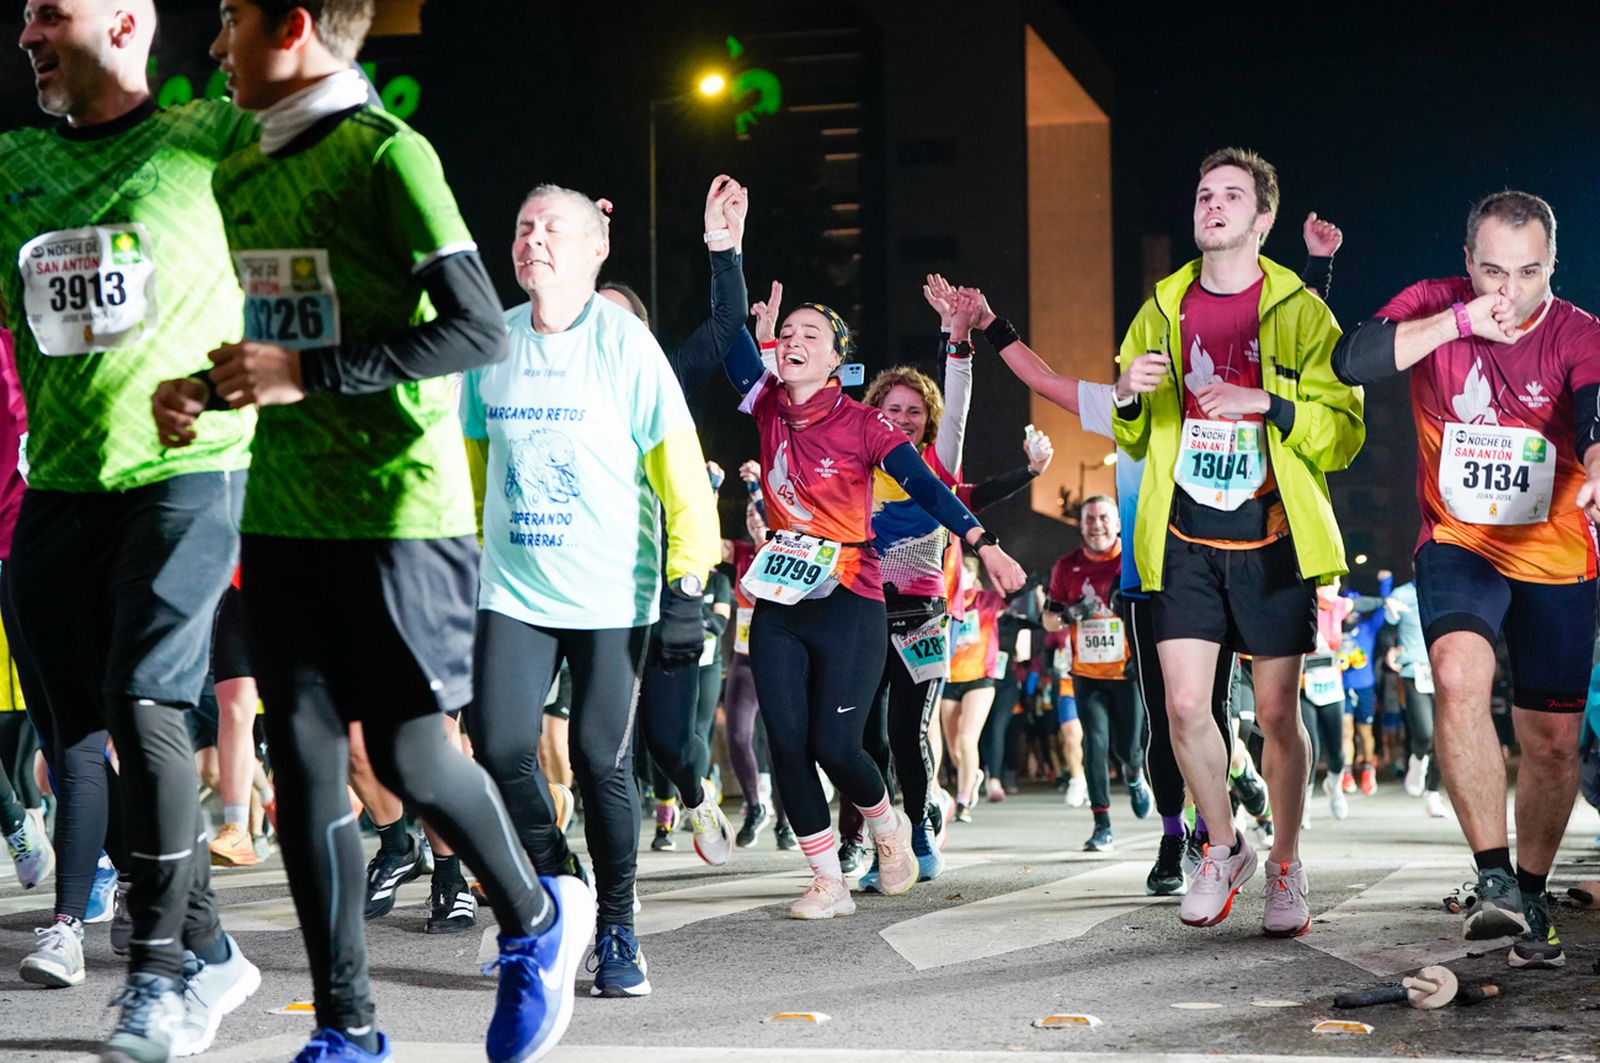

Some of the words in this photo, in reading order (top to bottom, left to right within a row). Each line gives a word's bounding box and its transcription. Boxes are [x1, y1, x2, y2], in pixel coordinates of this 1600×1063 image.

[47, 243, 82, 257] NOCHE
[85, 240, 98, 254] DE
[36, 260, 59, 275] SAN
[49, 271, 127, 312] 3913
[1190, 440, 1207, 450] SAN
[1468, 436, 1498, 447] NOCHE
[1501, 439, 1513, 449] DE
[1454, 446, 1475, 458] SAN
[1463, 460, 1530, 493] 3134
[770, 544, 786, 553] SAN
[764, 553, 822, 585] 13799
[1085, 635, 1115, 648] 5044
